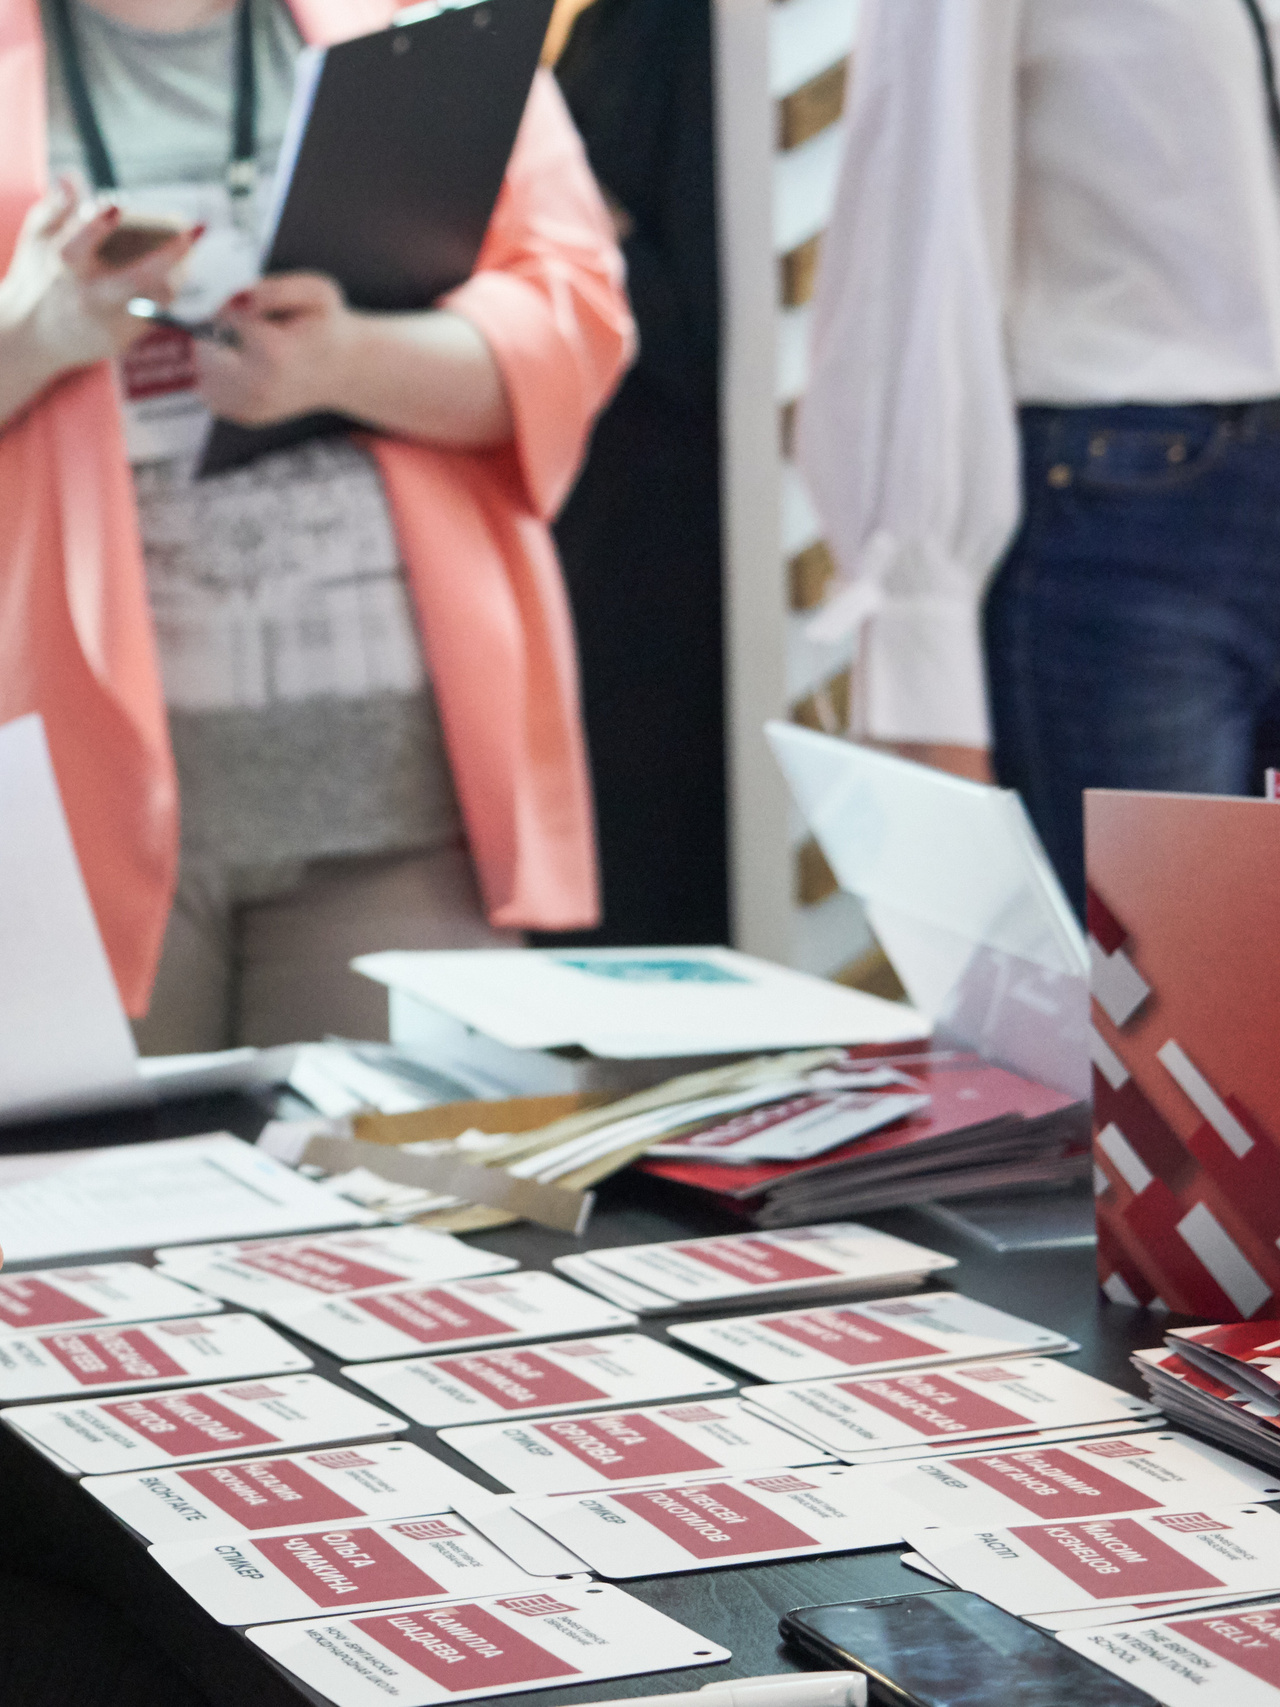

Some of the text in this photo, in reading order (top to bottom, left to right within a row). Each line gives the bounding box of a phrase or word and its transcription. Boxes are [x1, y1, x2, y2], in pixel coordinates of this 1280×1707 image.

[49, 1335, 109, 1372] СЕРГЕЕВ
[853, 1380, 973, 1431] ДЫМАРСКАЯ
[890, 1377, 965, 1404] ОЛЬГА
[109, 1402, 182, 1433] ТИТОВ
[150, 1395, 253, 1441] НИКОЛАЙ
[587, 1417, 652, 1445] ИНГА
[499, 1428, 555, 1457] СПИКЕР
[543, 1421, 632, 1464] ОРЛОВА
[203, 1468, 271, 1505] ЯКУНИНА
[236, 1464, 305, 1501] НАТАЛИЯ
[913, 1464, 970, 1489] СПИКЕР
[976, 1457, 1062, 1496] ЖИГАНОВ
[1006, 1453, 1105, 1497] ВЛАДИМИР
[136, 1476, 208, 1521] ВКОНТАКТЕ
[576, 1499, 628, 1525] СПИКЕР
[639, 1491, 734, 1542] ПОКОТИЛОВ
[673, 1487, 752, 1524] АЛЕКСЕЙ
[211, 1545, 266, 1580] СПИКЕР
[317, 1533, 381, 1568] ОЛЬГА
[972, 1532, 1022, 1558] РАСПП
[1037, 1526, 1124, 1574] КУЗНЕЦОВ
[1076, 1524, 1151, 1563] МАКСИМ
[276, 1537, 362, 1594] ЧУМАКИНА
[298, 1628, 375, 1675] МЕЖДУНАРОДНАЯ
[381, 1616, 473, 1663] ШАДАЕВА
[420, 1611, 510, 1658] КАМИЛЛА
[1087, 1635, 1140, 1665] SCHOOL
[1141, 1628, 1216, 1669] THE BRITISH
[1202, 1619, 1269, 1648] KELLY
[1113, 1631, 1210, 1686] INTERNATIONAL
